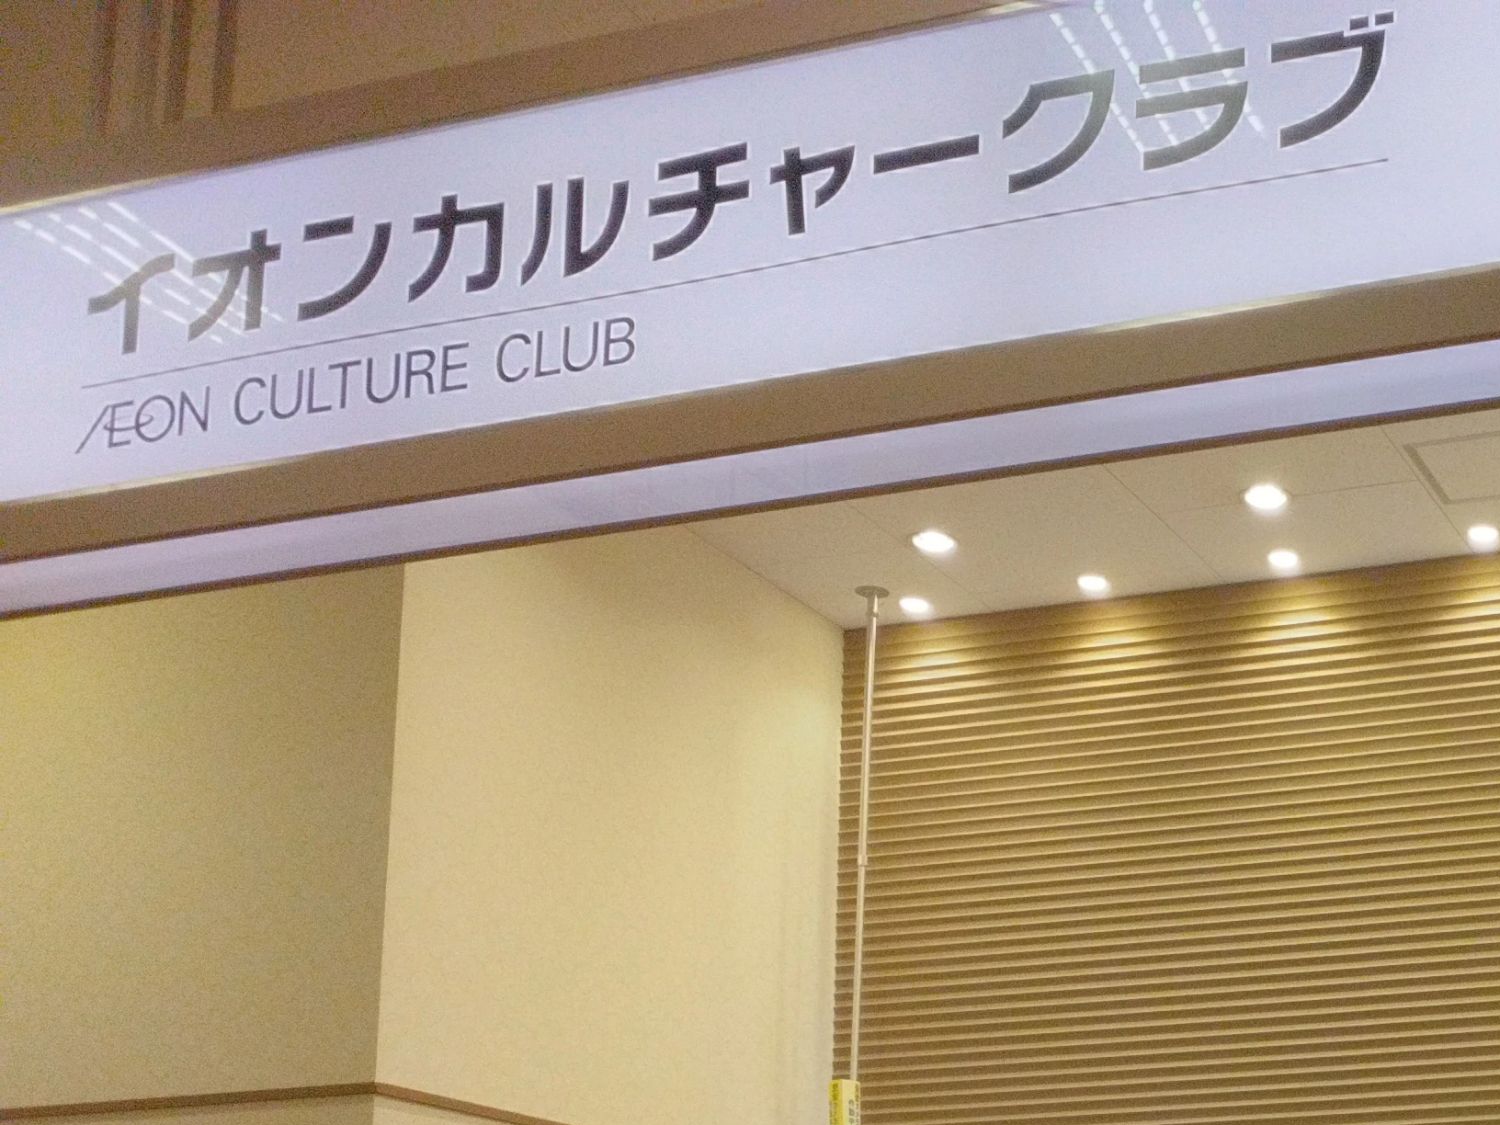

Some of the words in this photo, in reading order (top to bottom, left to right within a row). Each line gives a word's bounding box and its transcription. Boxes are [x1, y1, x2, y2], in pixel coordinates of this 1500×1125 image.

[88, 12, 1397, 355] イオンカルチャークラブ
[234, 342, 470, 428] CULTURE
[496, 316, 637, 384] CLUB
